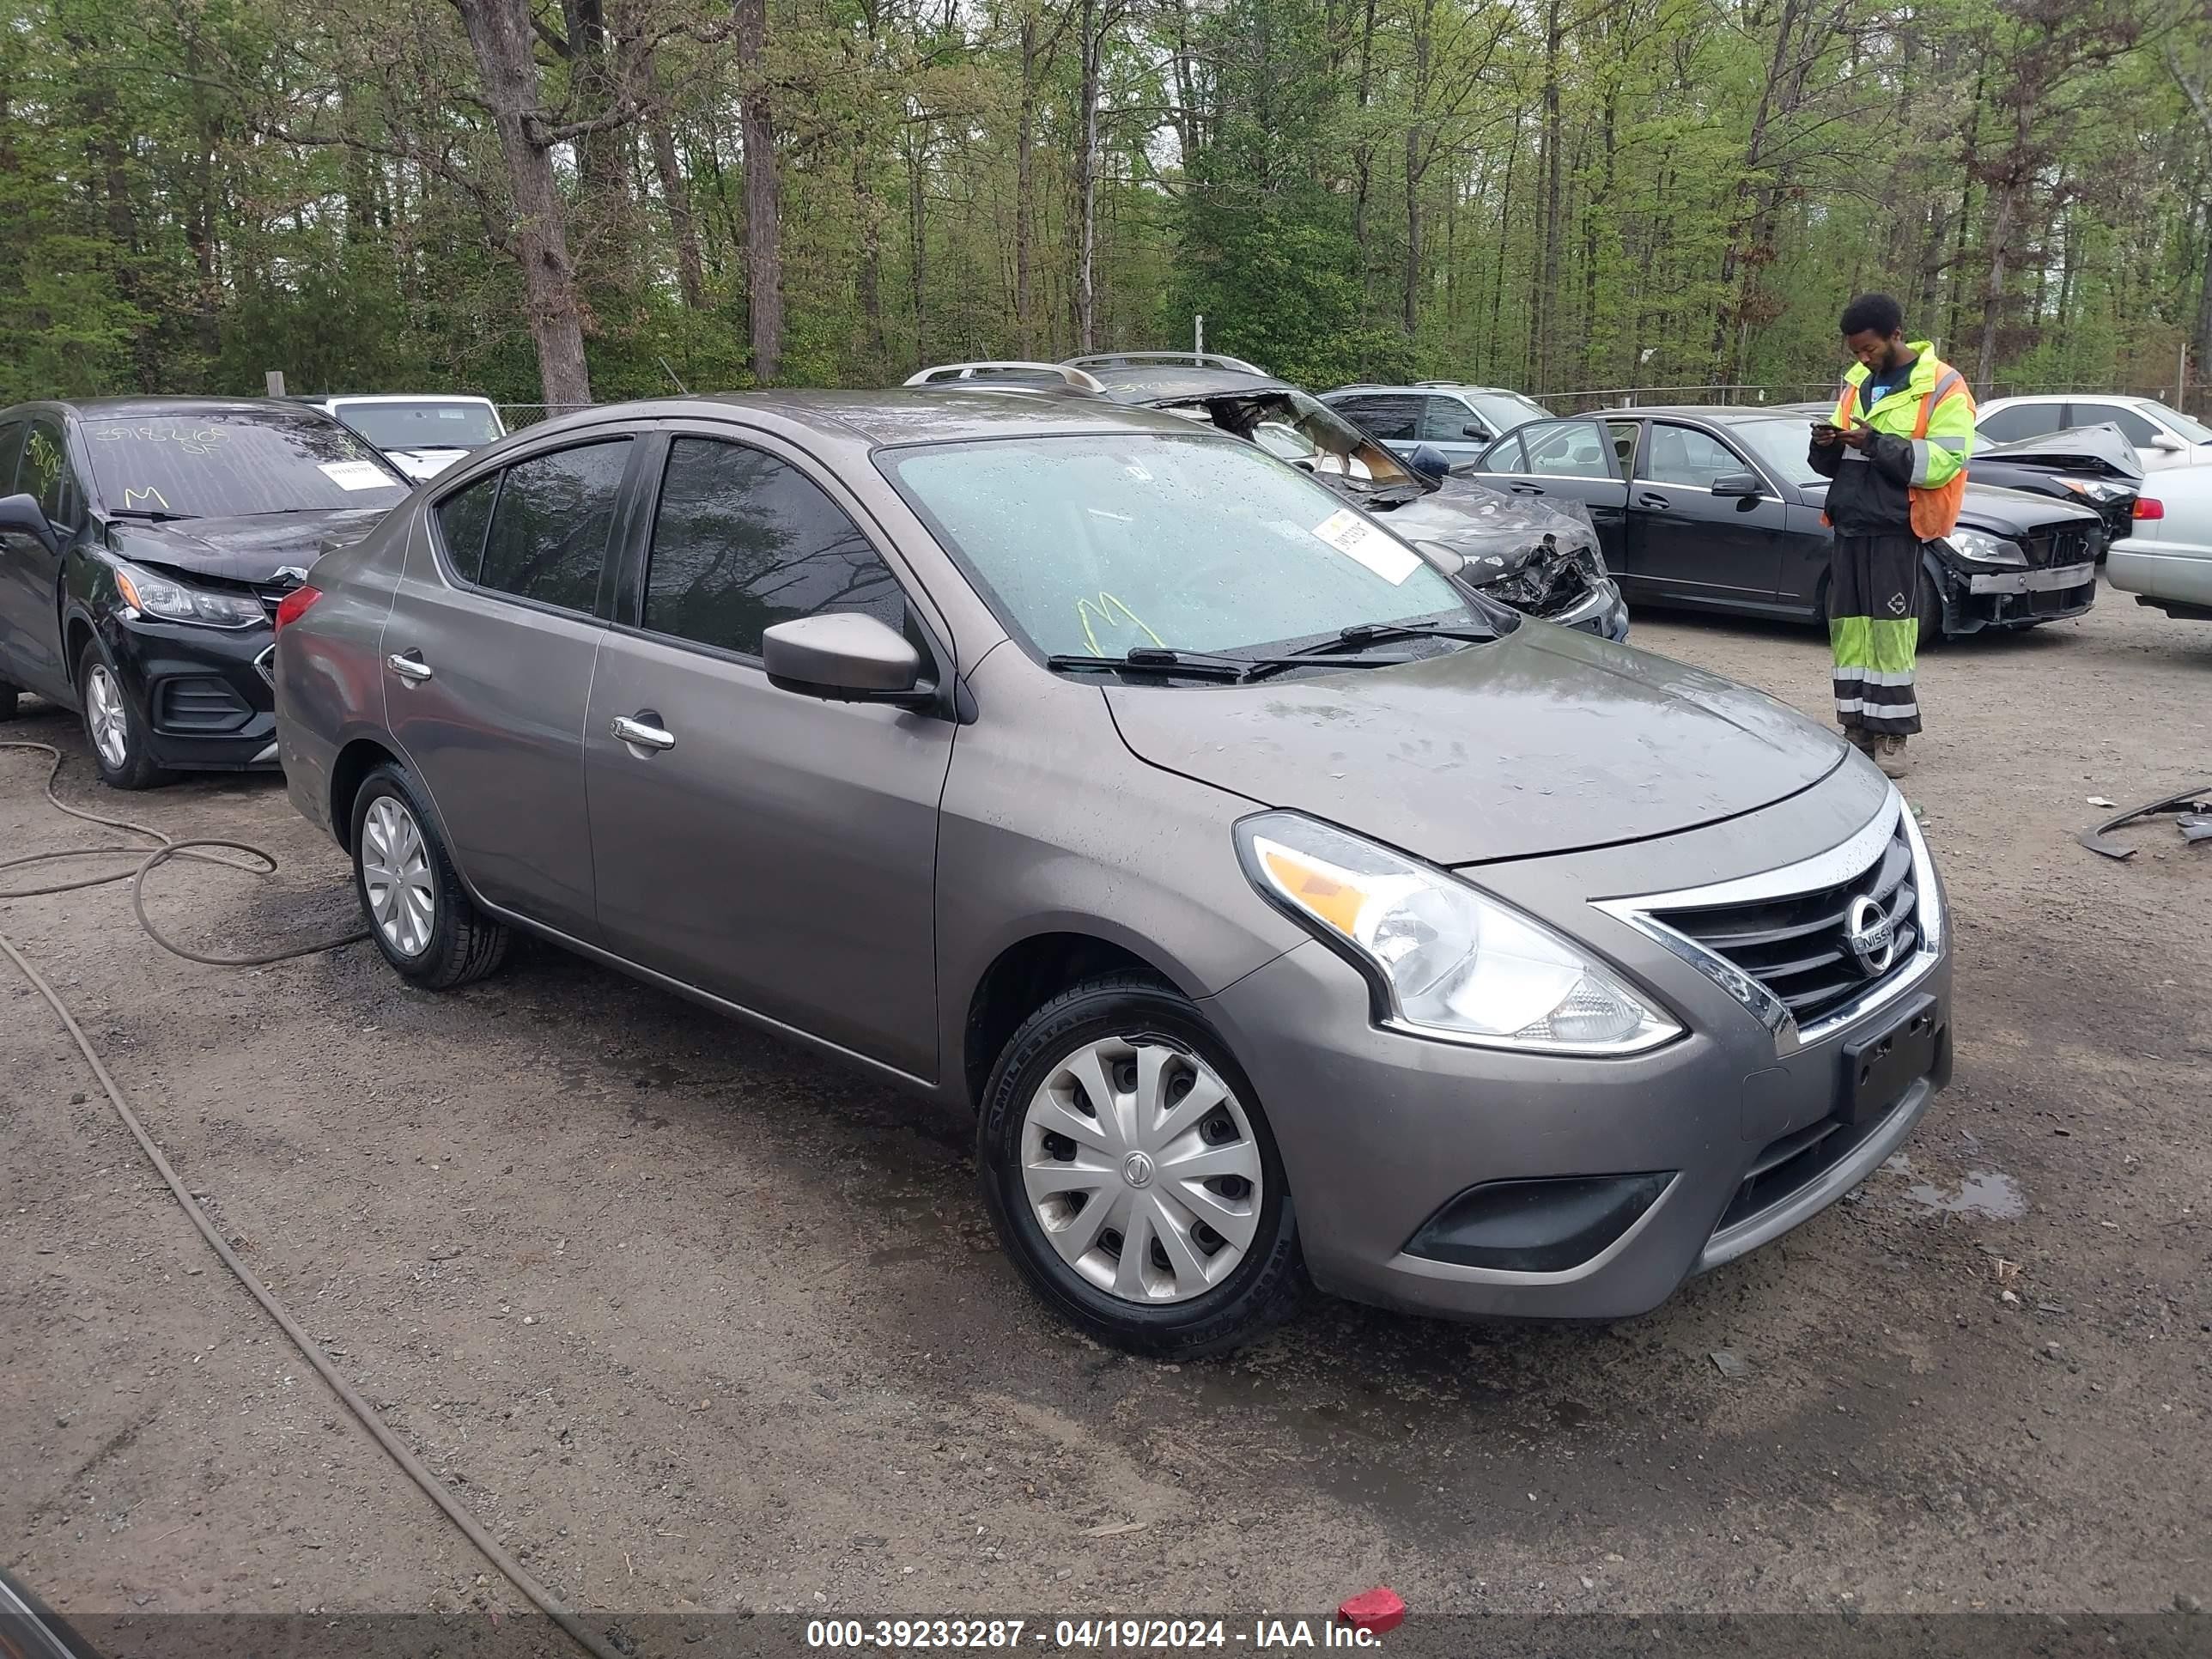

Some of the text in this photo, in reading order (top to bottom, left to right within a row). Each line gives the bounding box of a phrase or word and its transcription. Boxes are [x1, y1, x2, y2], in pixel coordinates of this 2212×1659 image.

[125, 486, 169, 509] M
[1077, 592, 1166, 659] M
[1863, 925, 1891, 949] NISSA
